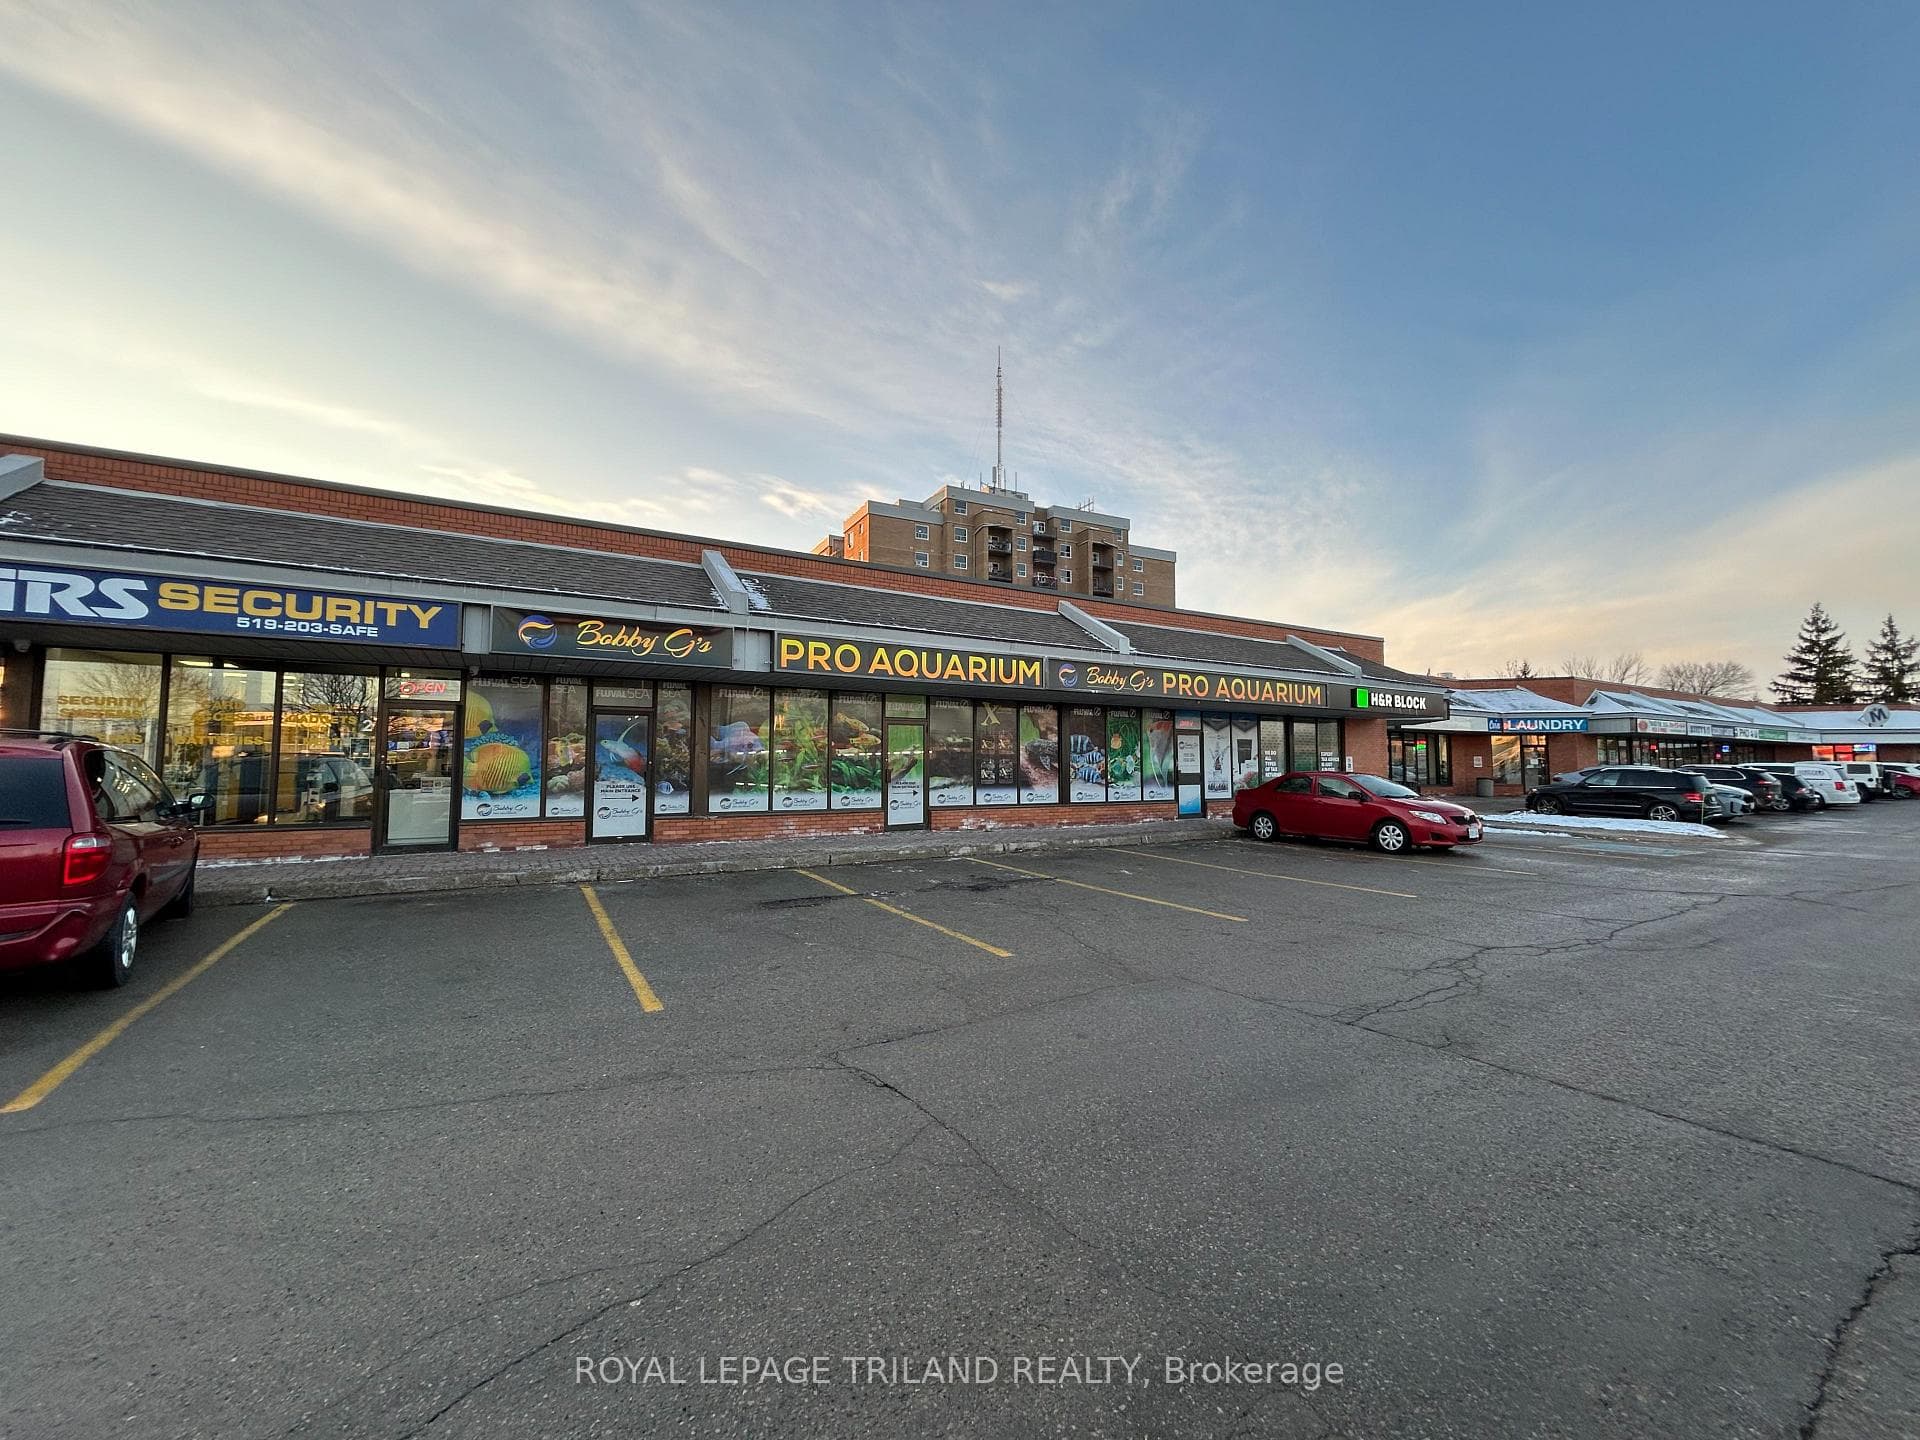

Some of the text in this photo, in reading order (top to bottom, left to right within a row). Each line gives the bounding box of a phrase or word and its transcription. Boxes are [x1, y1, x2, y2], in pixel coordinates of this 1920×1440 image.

[158, 582, 442, 629] SECURITY
[236, 616, 379, 637] 519-203-SAFE
[576, 620, 712, 658] Bobby G's
[780, 638, 1041, 686] PRO AQUARIUM
[511, 677, 538, 689] SEA
[556, 685, 577, 694] SEA
[1086, 666, 1321, 705] Bobby G's PRO AQUARIUM
[1371, 692, 1427, 710] H&R BLOCK
[1508, 719, 1585, 731] LAUNDRY
